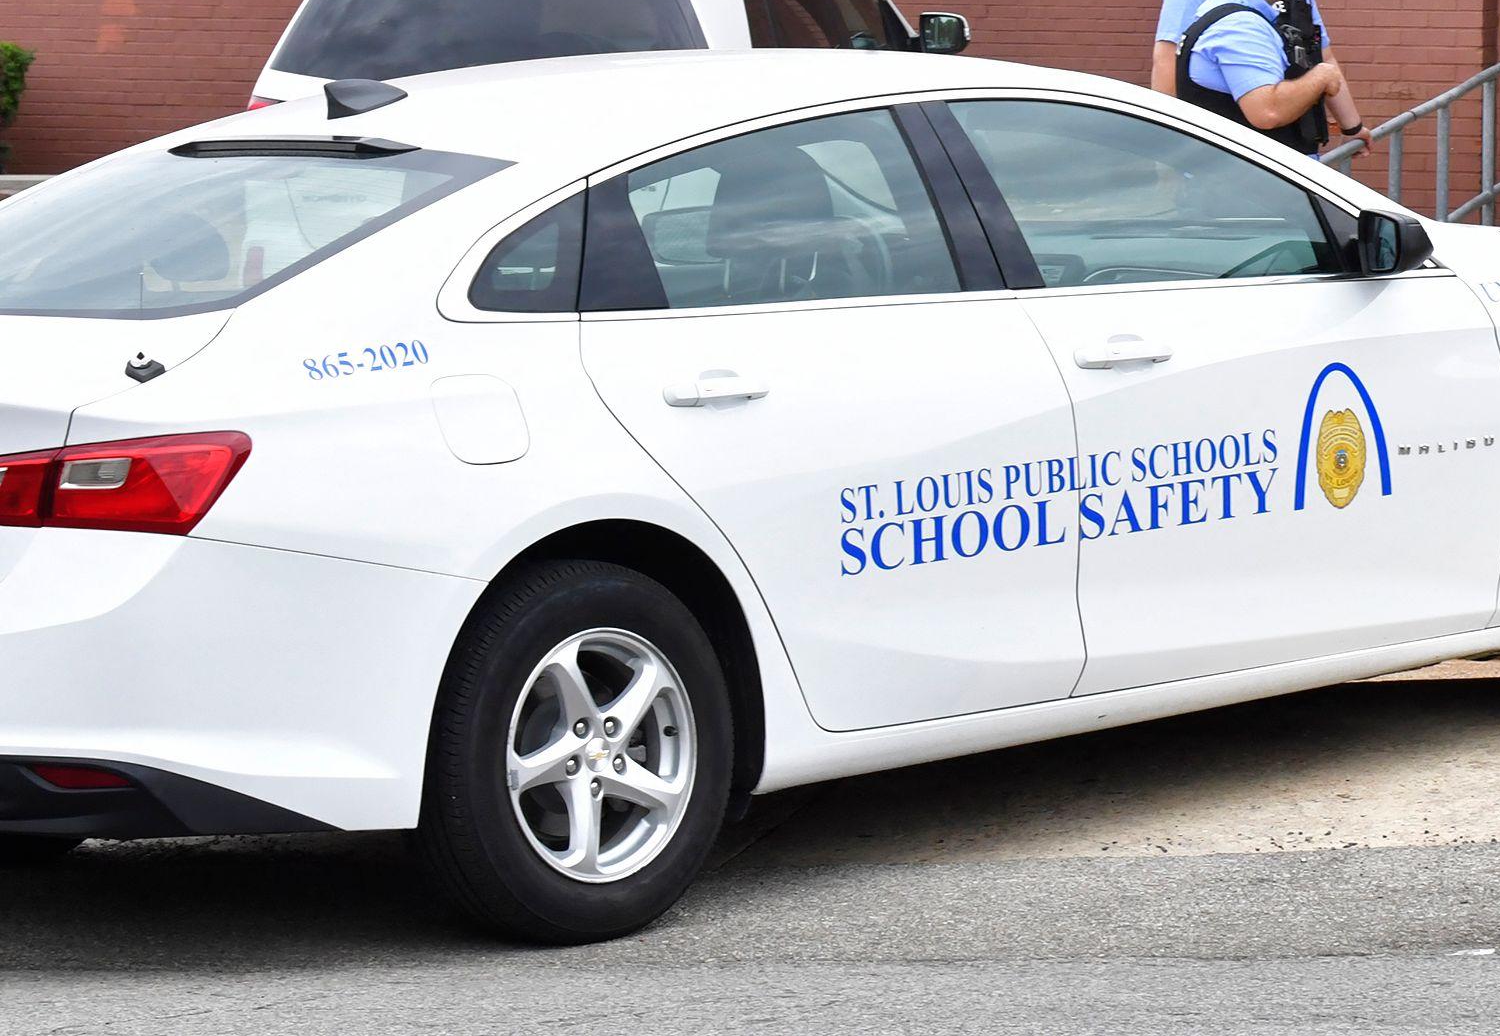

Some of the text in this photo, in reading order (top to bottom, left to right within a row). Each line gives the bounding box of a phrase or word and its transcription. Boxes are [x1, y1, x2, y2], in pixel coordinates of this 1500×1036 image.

[302, 338, 431, 381] 865-2020
[839, 428, 1279, 524] ST. LOUIS PUBLIC SCHOOLS
[1397, 435, 1495, 456] MALIBU
[840, 466, 1280, 577] SCHOOL SAFETY
